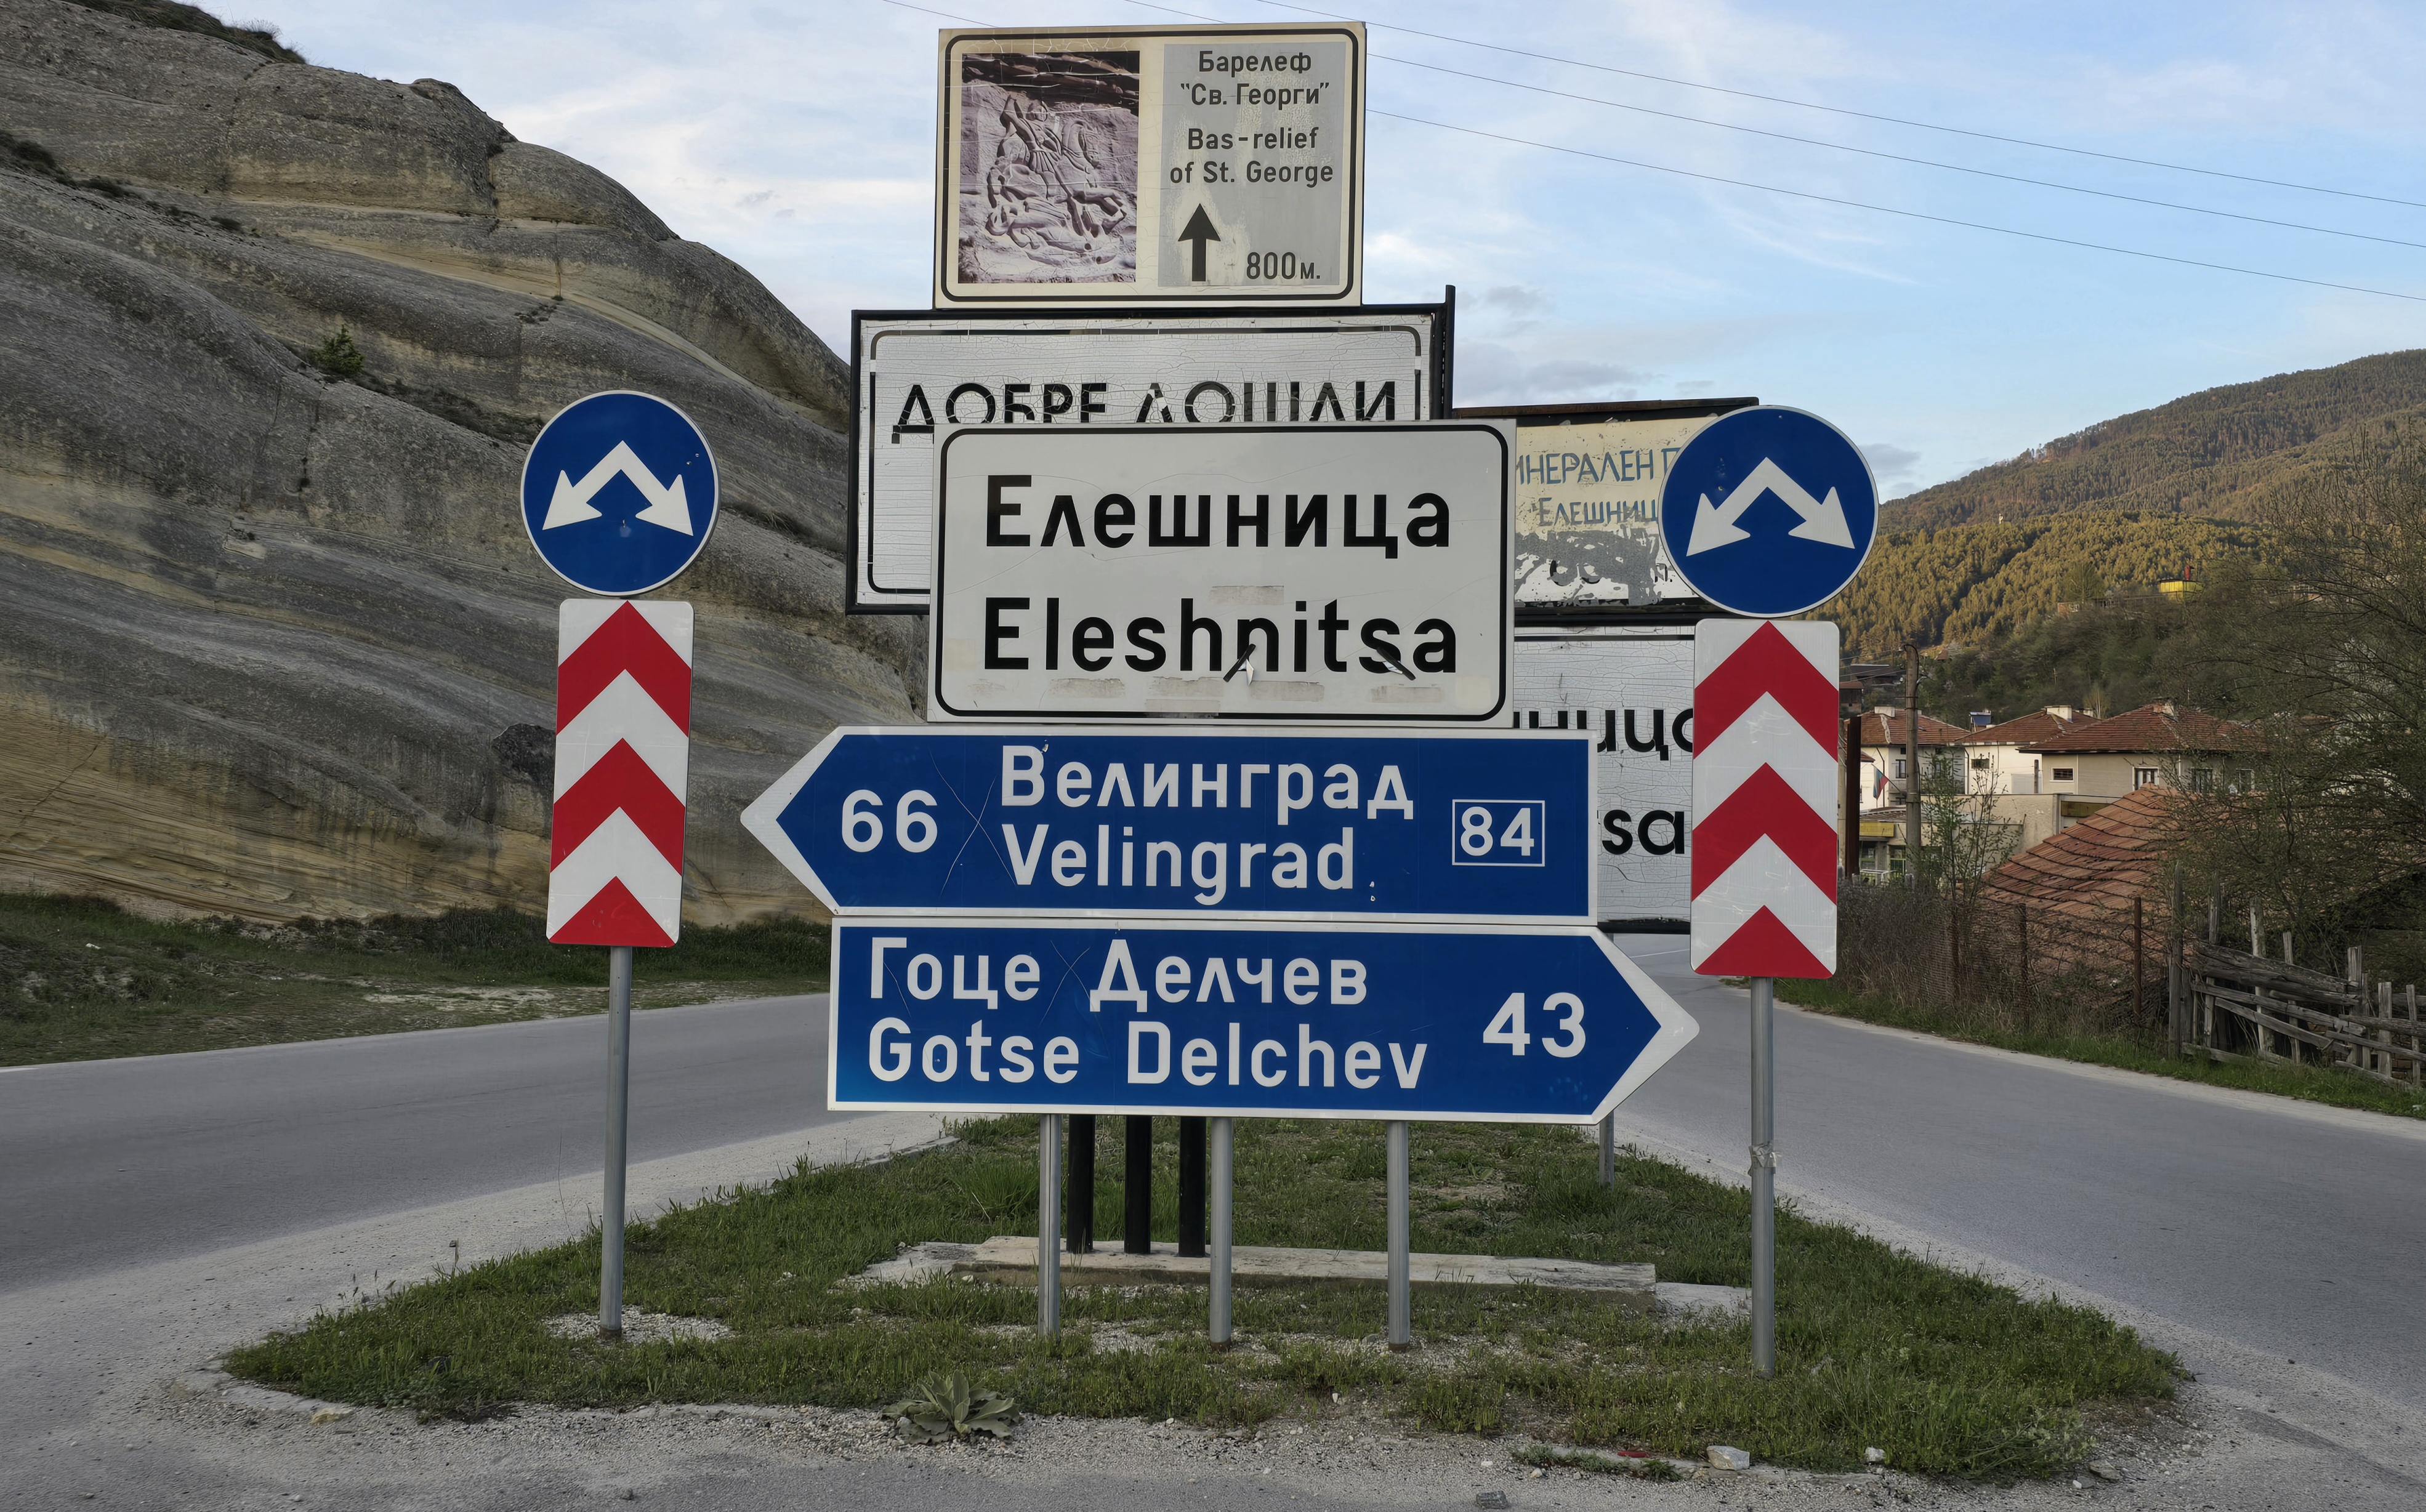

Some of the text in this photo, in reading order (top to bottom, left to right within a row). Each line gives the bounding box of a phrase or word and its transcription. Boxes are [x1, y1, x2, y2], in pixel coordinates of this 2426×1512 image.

[1199, 50, 1312, 78] Барелеф
[1170, 160, 1333, 187] of St. George
[986, 474, 1450, 558] Елешница
[985, 597, 1457, 674] Eleshnitsa
[841, 789, 938, 853] 66
[1001, 745, 1414, 826] Велинград
[1001, 824, 1353, 906] Velingrad
[1459, 806, 1534, 856] 84
[870, 936, 1367, 1012] Гоце Делчев
[869, 1016, 1427, 1089] Gotse Delchev
[1482, 992, 1587, 1058] 43
